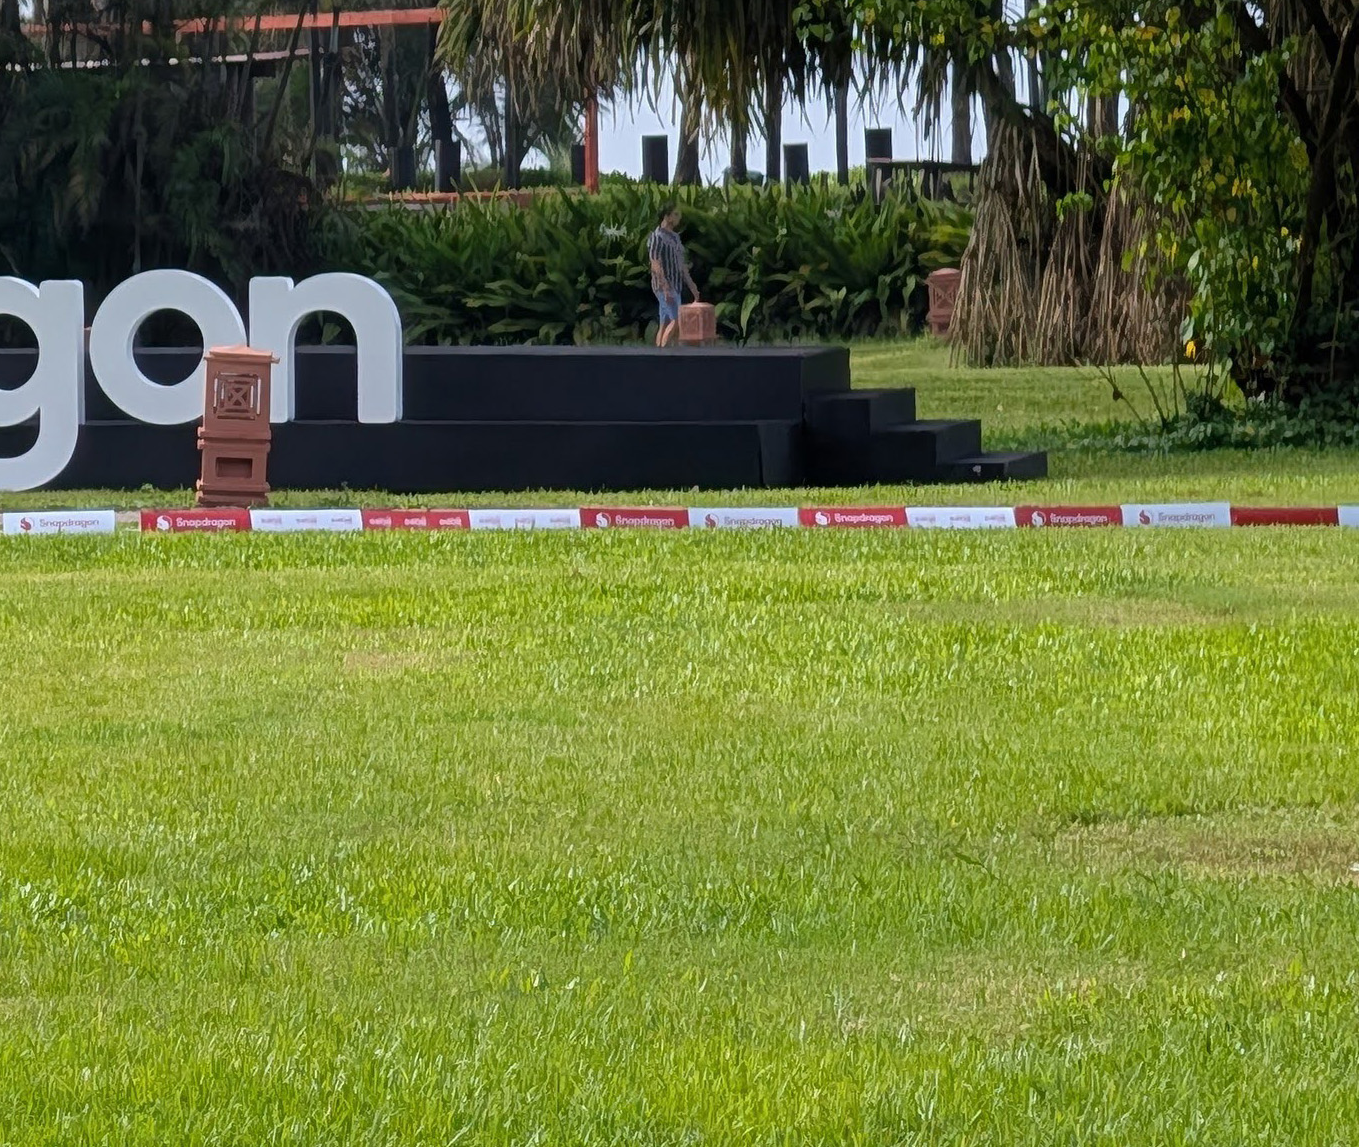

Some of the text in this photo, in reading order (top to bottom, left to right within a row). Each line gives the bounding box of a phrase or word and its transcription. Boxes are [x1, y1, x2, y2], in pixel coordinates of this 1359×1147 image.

[175, 516, 236, 528] Snapdragon
[615, 514, 675, 527] Snapdragon
[833, 512, 894, 524] Snapdragon
[1049, 512, 1108, 525] Snapdragon
[1158, 511, 1216, 522] Snapdragon
[39, 517, 100, 529] Snapdragon
